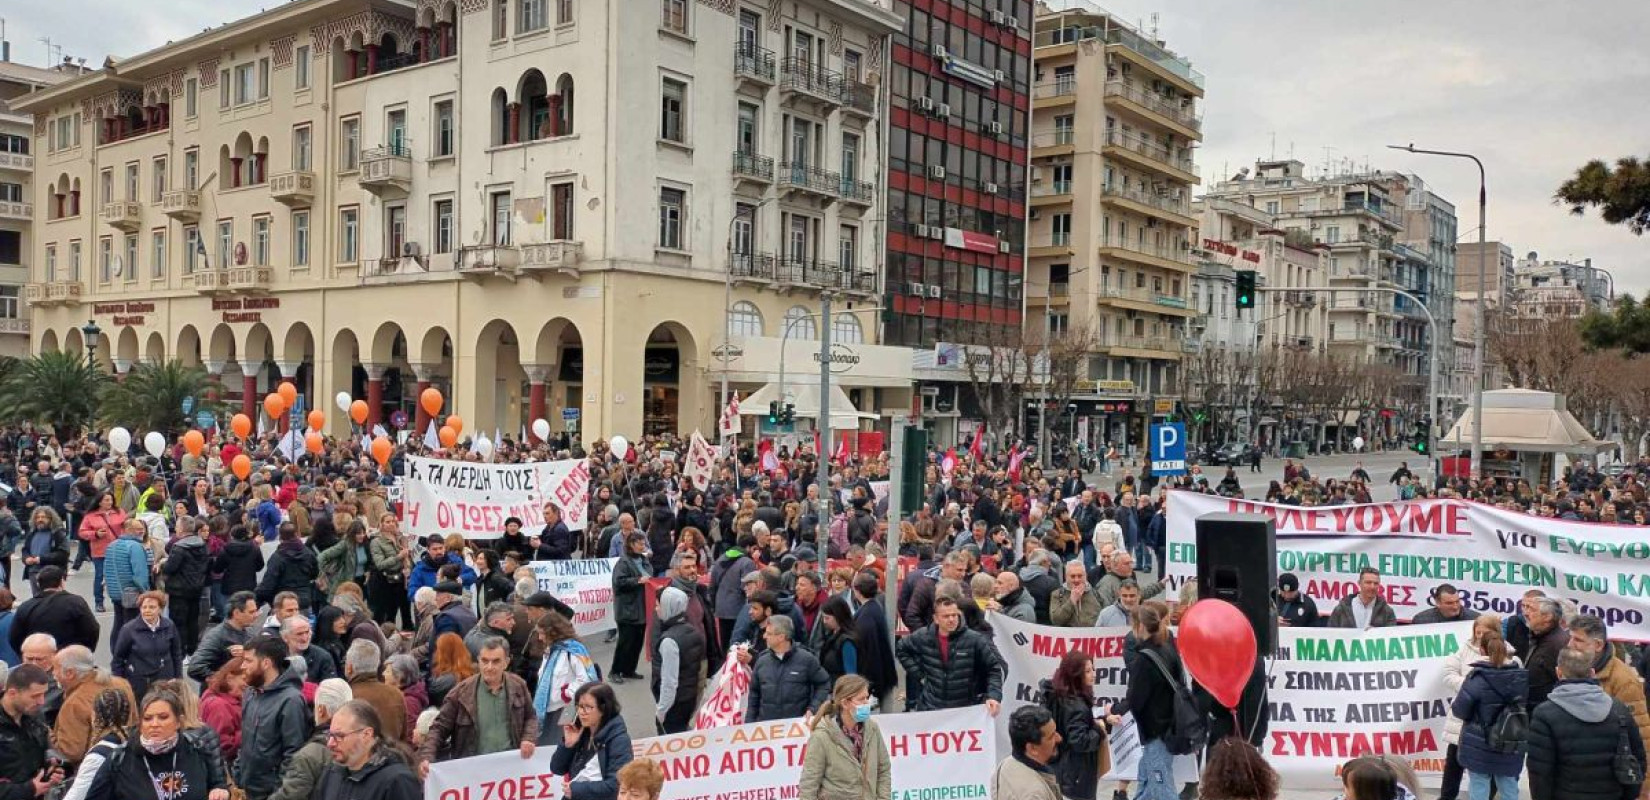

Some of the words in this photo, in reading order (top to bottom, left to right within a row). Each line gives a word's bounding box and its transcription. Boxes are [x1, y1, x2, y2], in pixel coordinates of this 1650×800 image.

[1160, 426, 1178, 459] P
[428, 464, 444, 485] ΤΑ
[447, 466, 492, 490] ΚΕΡΔΗ
[496, 469, 533, 490] ΤΟΥΣ
[437, 501, 455, 529] ΟΙ
[456, 502, 506, 532] ΖΩΕΣ
[1496, 529, 1537, 550] για
[1276, 550, 1371, 573] ΟΥΡΓΕΙΑ
[1378, 553, 1557, 588] ΕΠΙΧΕΙΡΗΣΕΩΝ
[1563, 572, 1608, 595] του
[1306, 578, 1417, 606] ΑΜΟΒΕΣ
[1032, 633, 1125, 659] ΜΑΖΙΚΕΣ
[1295, 633, 1460, 661] ΜΑΛΑΜΑΤΙΝΑ
[1284, 669, 1418, 691] ΣΩΜΑΤΕΙΟΥ
[730, 721, 808, 745] ΑΔΕΔ
[1271, 728, 1438, 757] ΣΥΝΤΑΓΜΑ
[659, 753, 710, 782] ΑΝΩ
[719, 747, 775, 775] ΑΠΟ
[916, 729, 983, 756] ΤΟΥΣ
[480, 773, 555, 800] ΖΩΕΣ
[902, 783, 987, 800] ΑΞΙΟΠΡΕΠΕΙΑ
